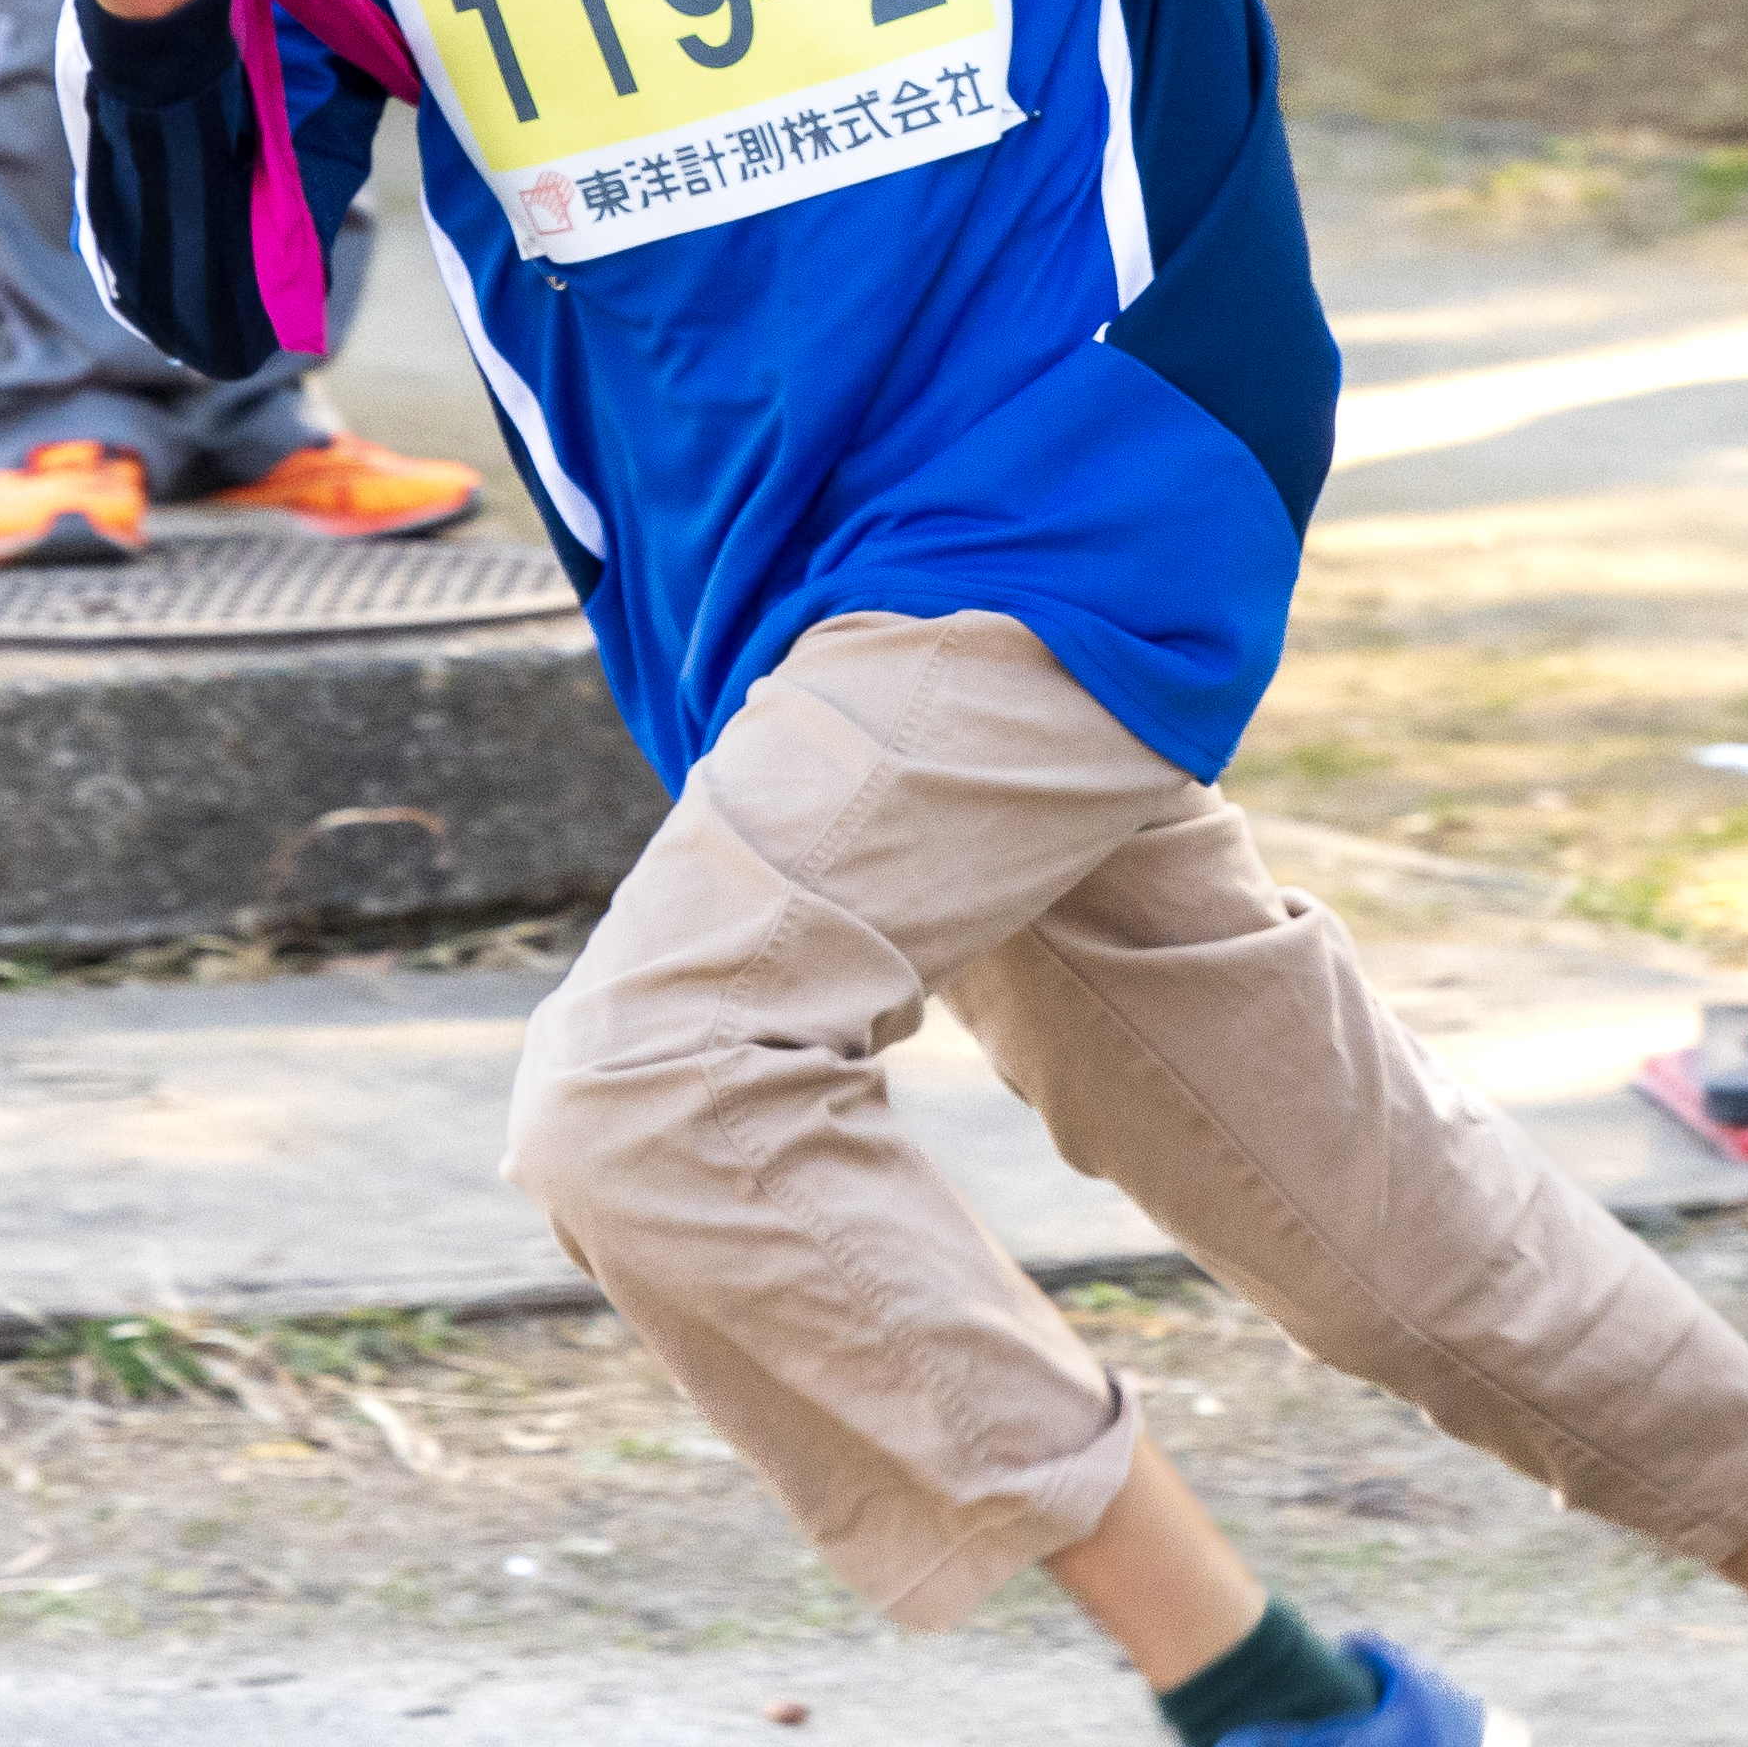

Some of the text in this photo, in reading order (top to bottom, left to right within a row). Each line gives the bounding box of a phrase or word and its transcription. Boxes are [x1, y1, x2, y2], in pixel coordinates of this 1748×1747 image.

[575, 61, 994, 224] 東洋計測株式会社
